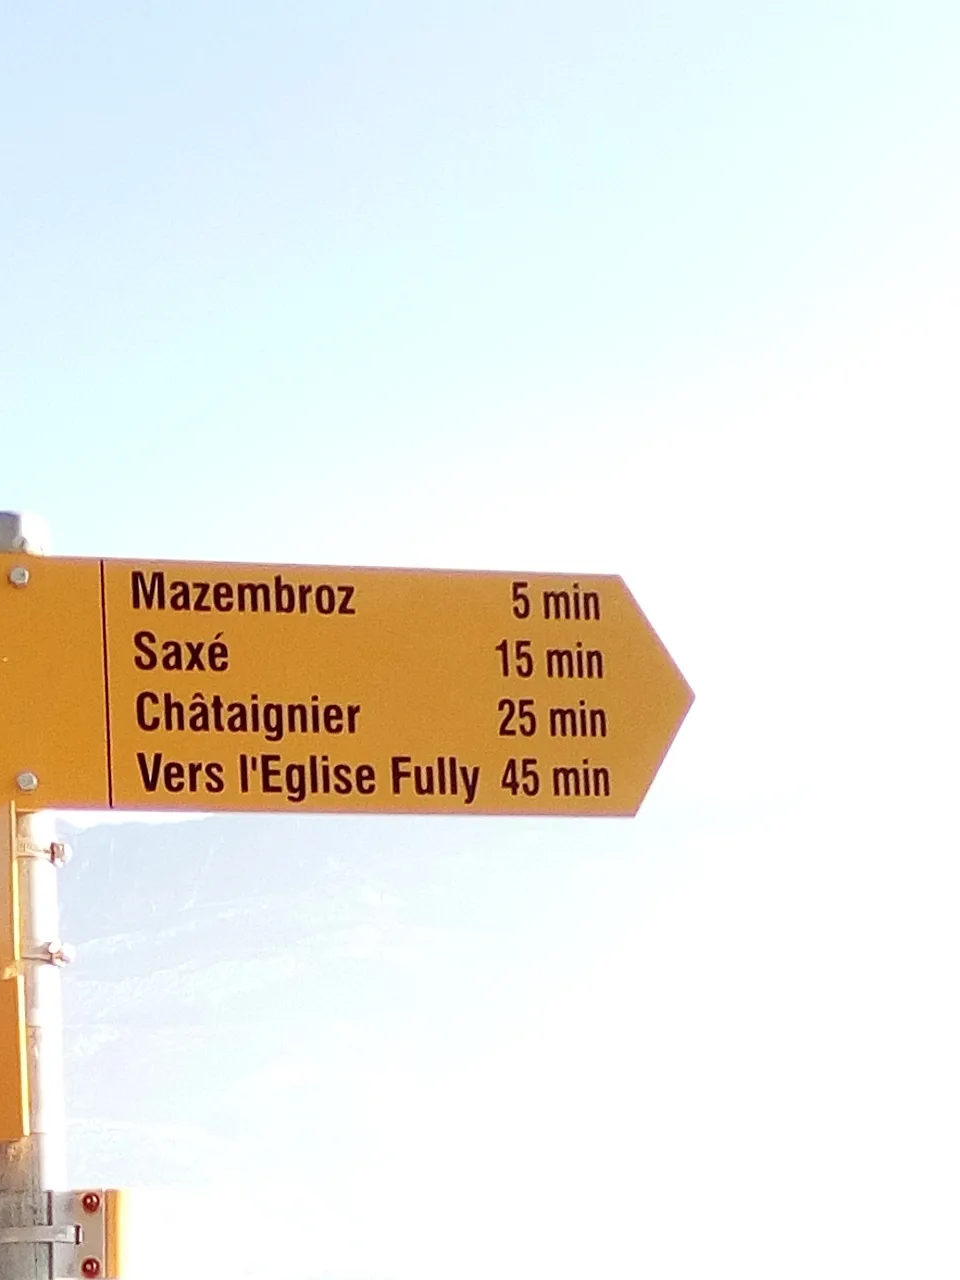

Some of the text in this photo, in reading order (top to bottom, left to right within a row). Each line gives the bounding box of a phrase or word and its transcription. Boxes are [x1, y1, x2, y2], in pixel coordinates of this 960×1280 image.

[131, 571, 356, 616] Mazembroz
[511, 582, 601, 621] 5 min
[133, 631, 230, 673] Saxé
[494, 640, 604, 681] 15 min
[135, 692, 361, 742] Châtaignier
[497, 698, 608, 739] 25 min
[136, 752, 480, 804] Vers l'Eglise Fully
[501, 758, 611, 799] 45 min
